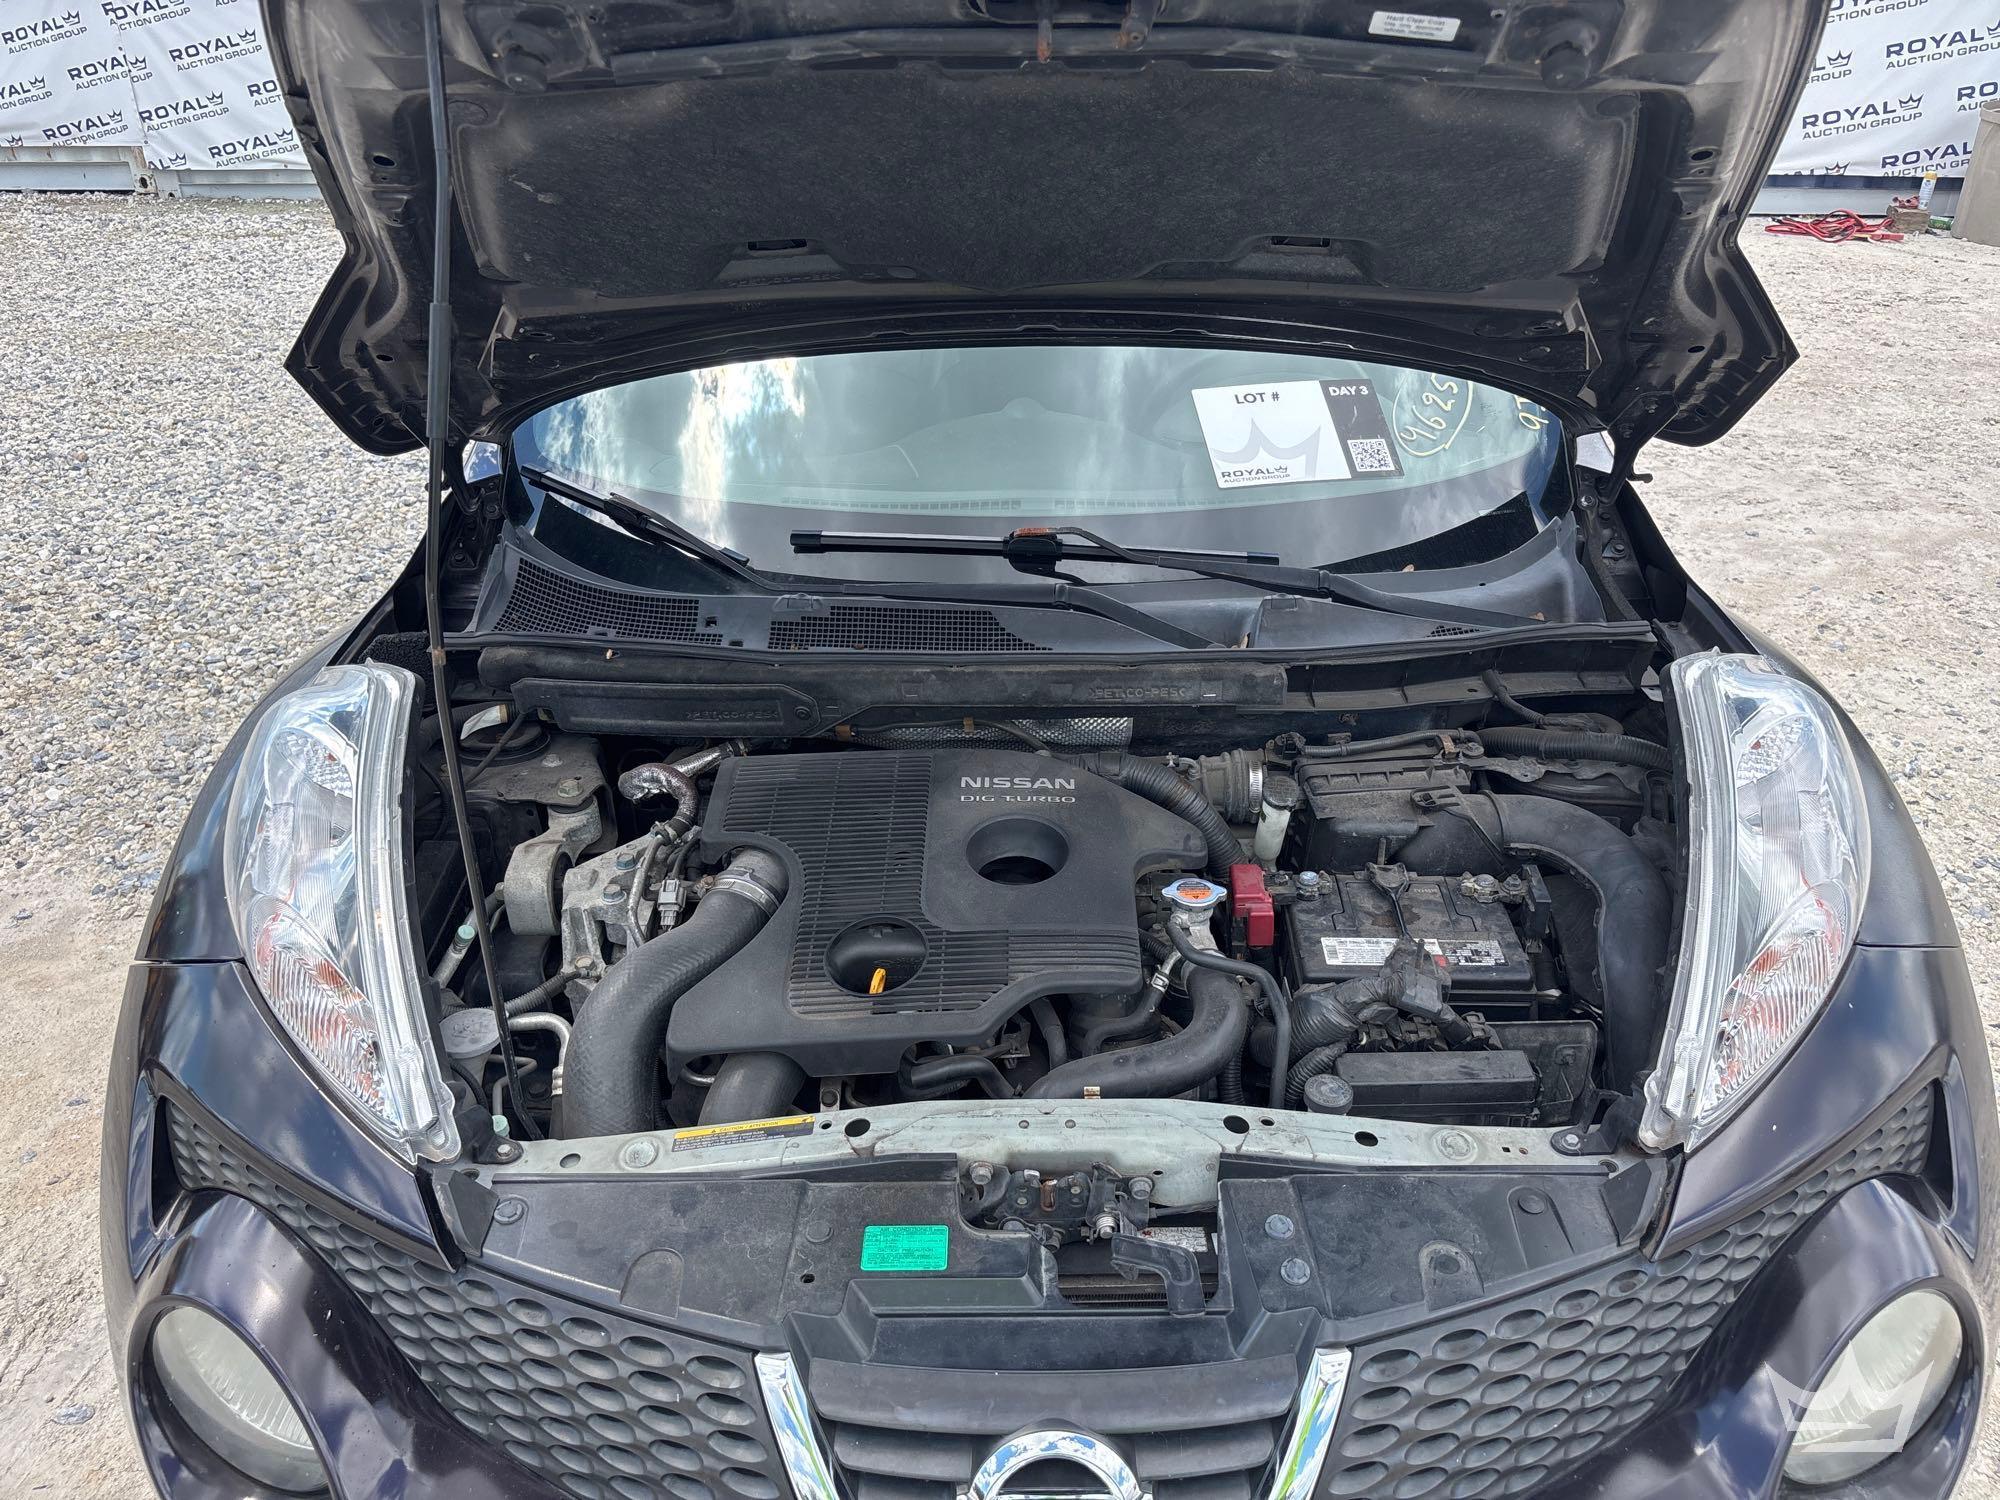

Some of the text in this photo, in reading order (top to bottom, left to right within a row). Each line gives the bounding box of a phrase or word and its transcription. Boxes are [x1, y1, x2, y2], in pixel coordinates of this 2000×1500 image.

[110, 7, 191, 31] ACTION GROUP
[1826, 8, 1872, 23] CTION
[1, 17, 64, 44] ROYAL
[9, 26, 87, 54] AUCTION GROUP
[169, 35, 240, 62] ROYAL
[1886, 28, 1984, 58] ROYAL
[177, 44, 262, 72] AUCTION GROUP
[1886, 41, 2000, 70] AUCTION GROU
[0, 82, 31, 100] YAL
[76, 71, 153, 91] AUCTION GOUP
[18, 91, 53, 105] GROUP
[139, 97, 209, 123] ROYAL
[254, 94, 282, 108] AUCT
[146, 107, 230, 132] AUCTION GROUP
[1802, 101, 1897, 129] ROYAL
[1802, 112, 1923, 140] AUCTION GROUP
[42, 116, 110, 140] ROYAL
[52, 124, 129, 147] AUCTION GROUP
[208, 134, 277, 159] ROYAL
[215, 143, 300, 169] AUCTION GROUP
[1881, 142, 1973, 168] ROYAL
[1234, 391, 1280, 404] LOT #
[1328, 386, 1369, 396] DAY 3
[1221, 467, 1275, 478] ROYAL
[960, 777, 1075, 789] NISSAN
[1001, 795, 1076, 803] TURBO
